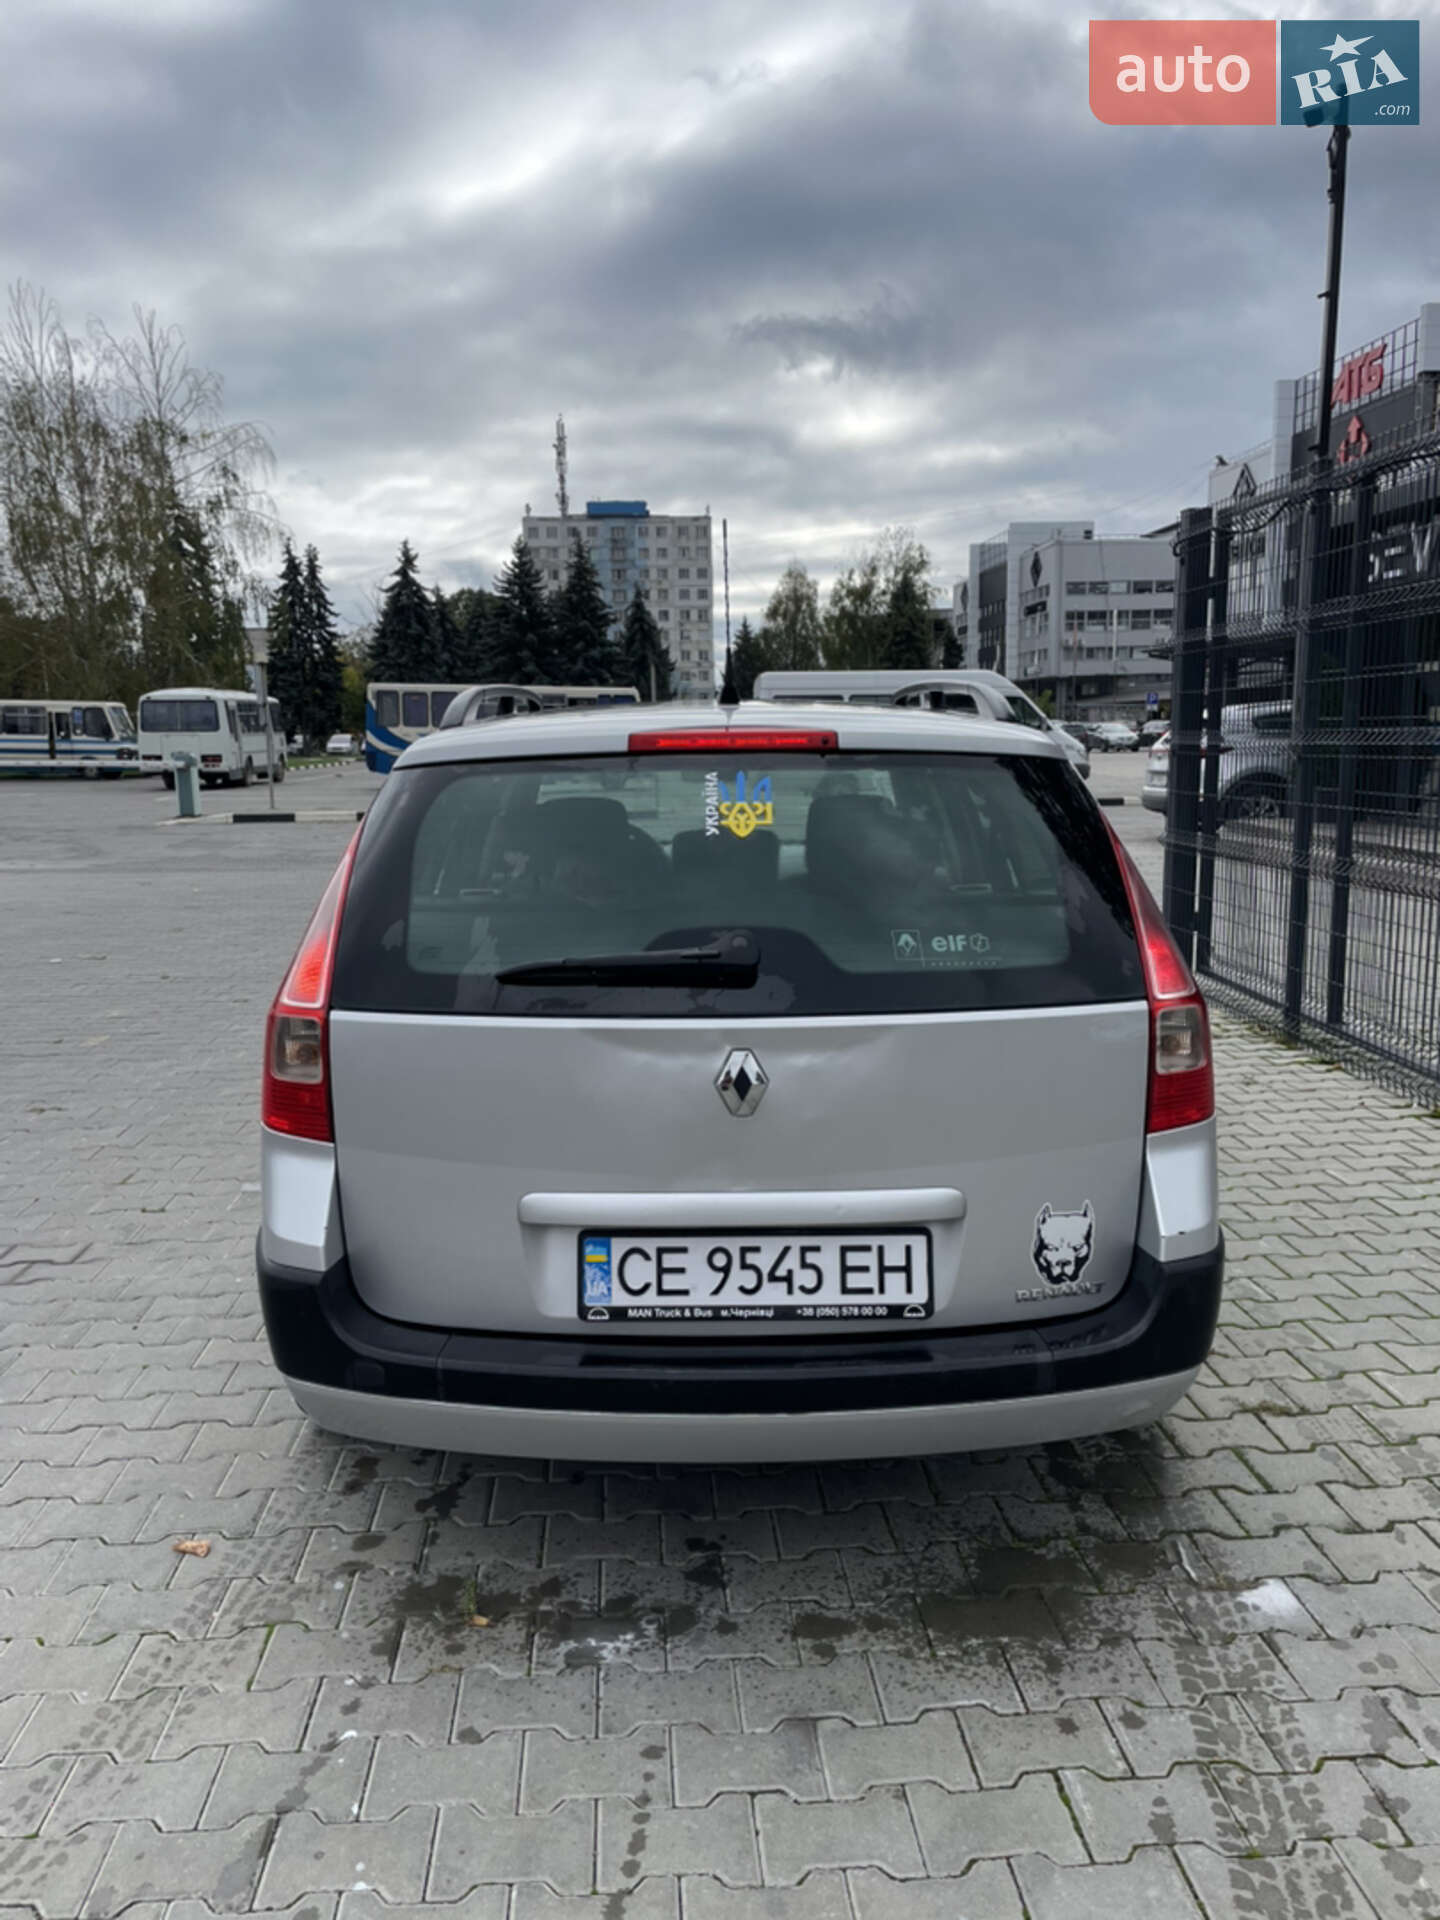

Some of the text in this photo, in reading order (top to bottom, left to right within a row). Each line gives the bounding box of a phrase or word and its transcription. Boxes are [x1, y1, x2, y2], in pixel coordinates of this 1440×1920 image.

[702, 771, 719, 836] УКРАЇНА
[931, 934, 967, 952] elf
[617, 1244, 913, 1297] CE 9545 EH
[627, 1307, 653, 1318] MAN
[654, 1307, 682, 1318] Truck
[693, 1307, 713, 1318] Bus
[796, 1306, 814, 1317] +38
